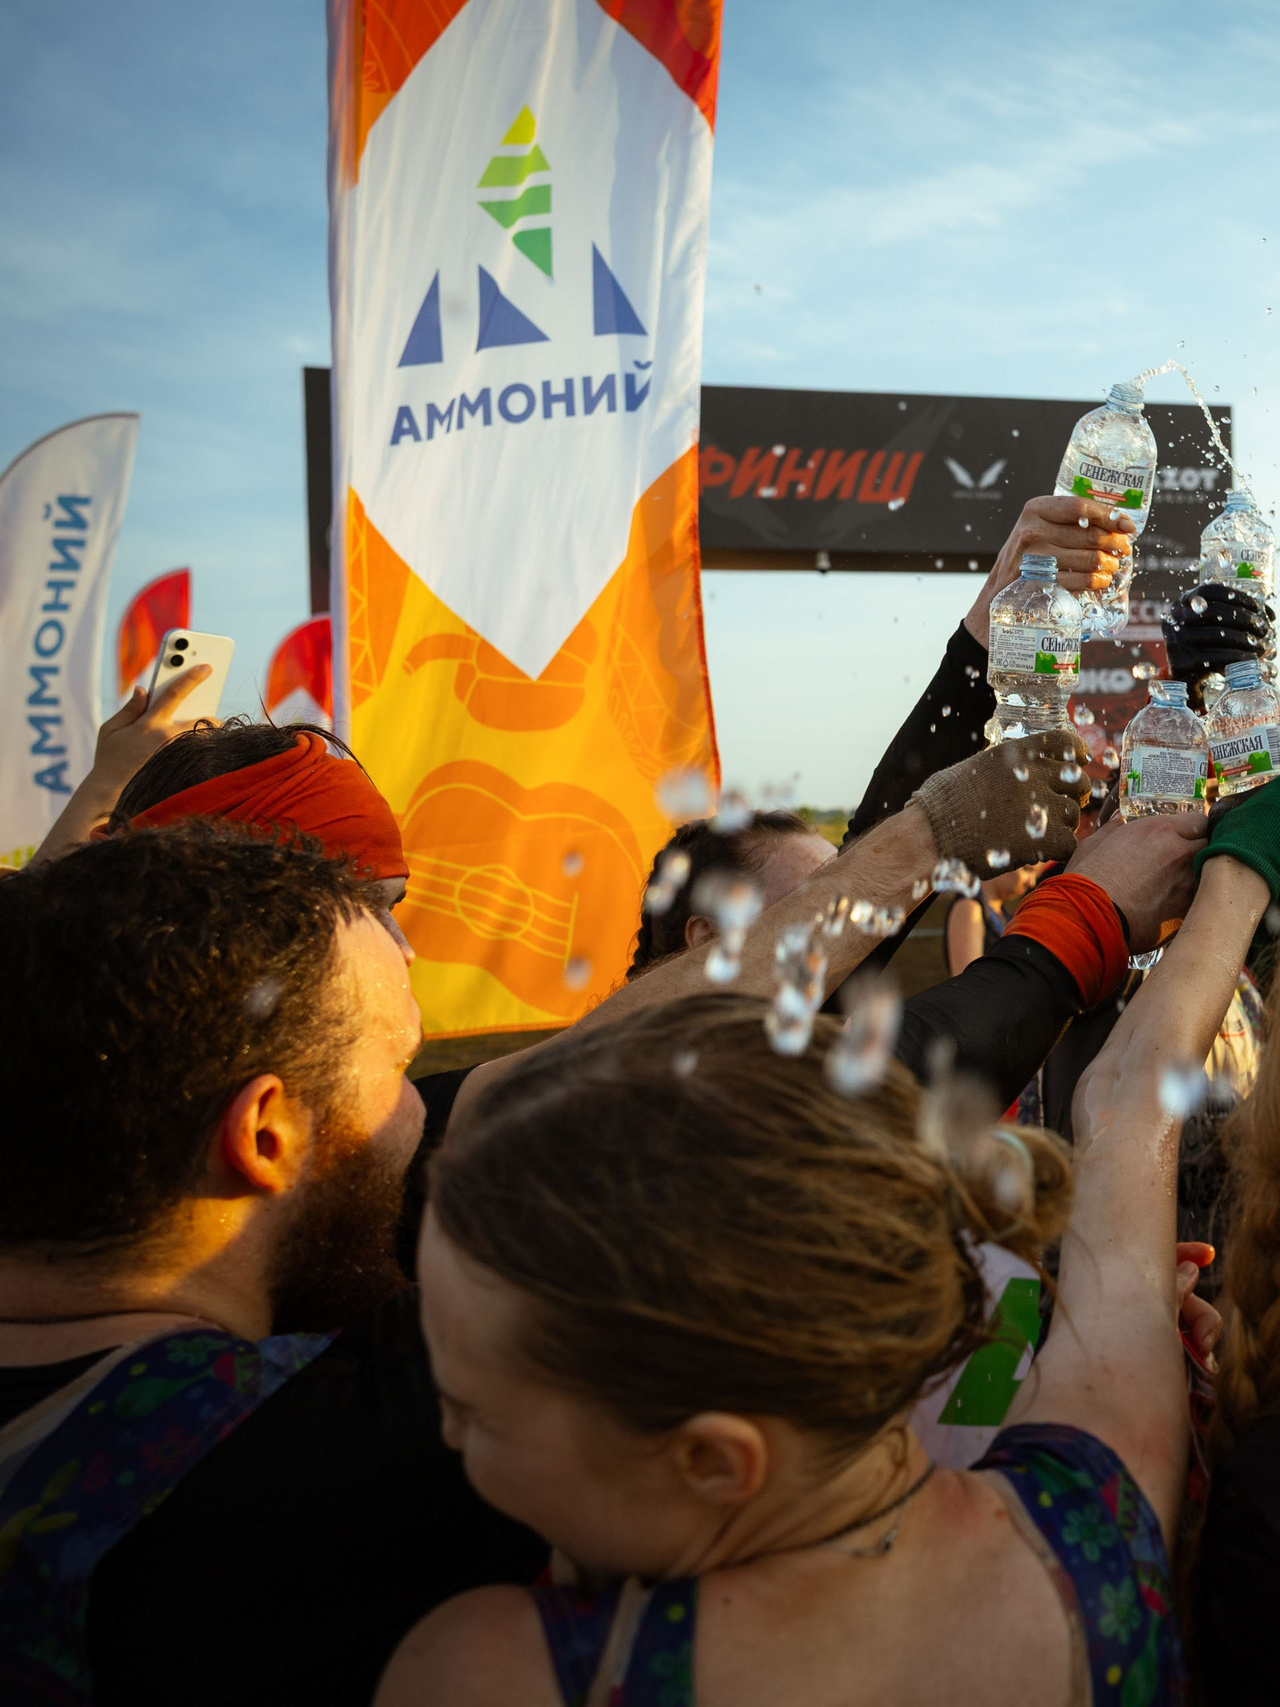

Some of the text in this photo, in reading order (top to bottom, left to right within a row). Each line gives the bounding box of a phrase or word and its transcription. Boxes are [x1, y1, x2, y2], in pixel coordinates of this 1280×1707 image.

[390, 360, 652, 446] АММОНИЙ
[1080, 461, 1144, 488] СЕНЕЖСКАЯ
[27, 494, 92, 795] АММОНИЙ
[1210, 735, 1263, 760] ЕНЕЖСКАЯ
